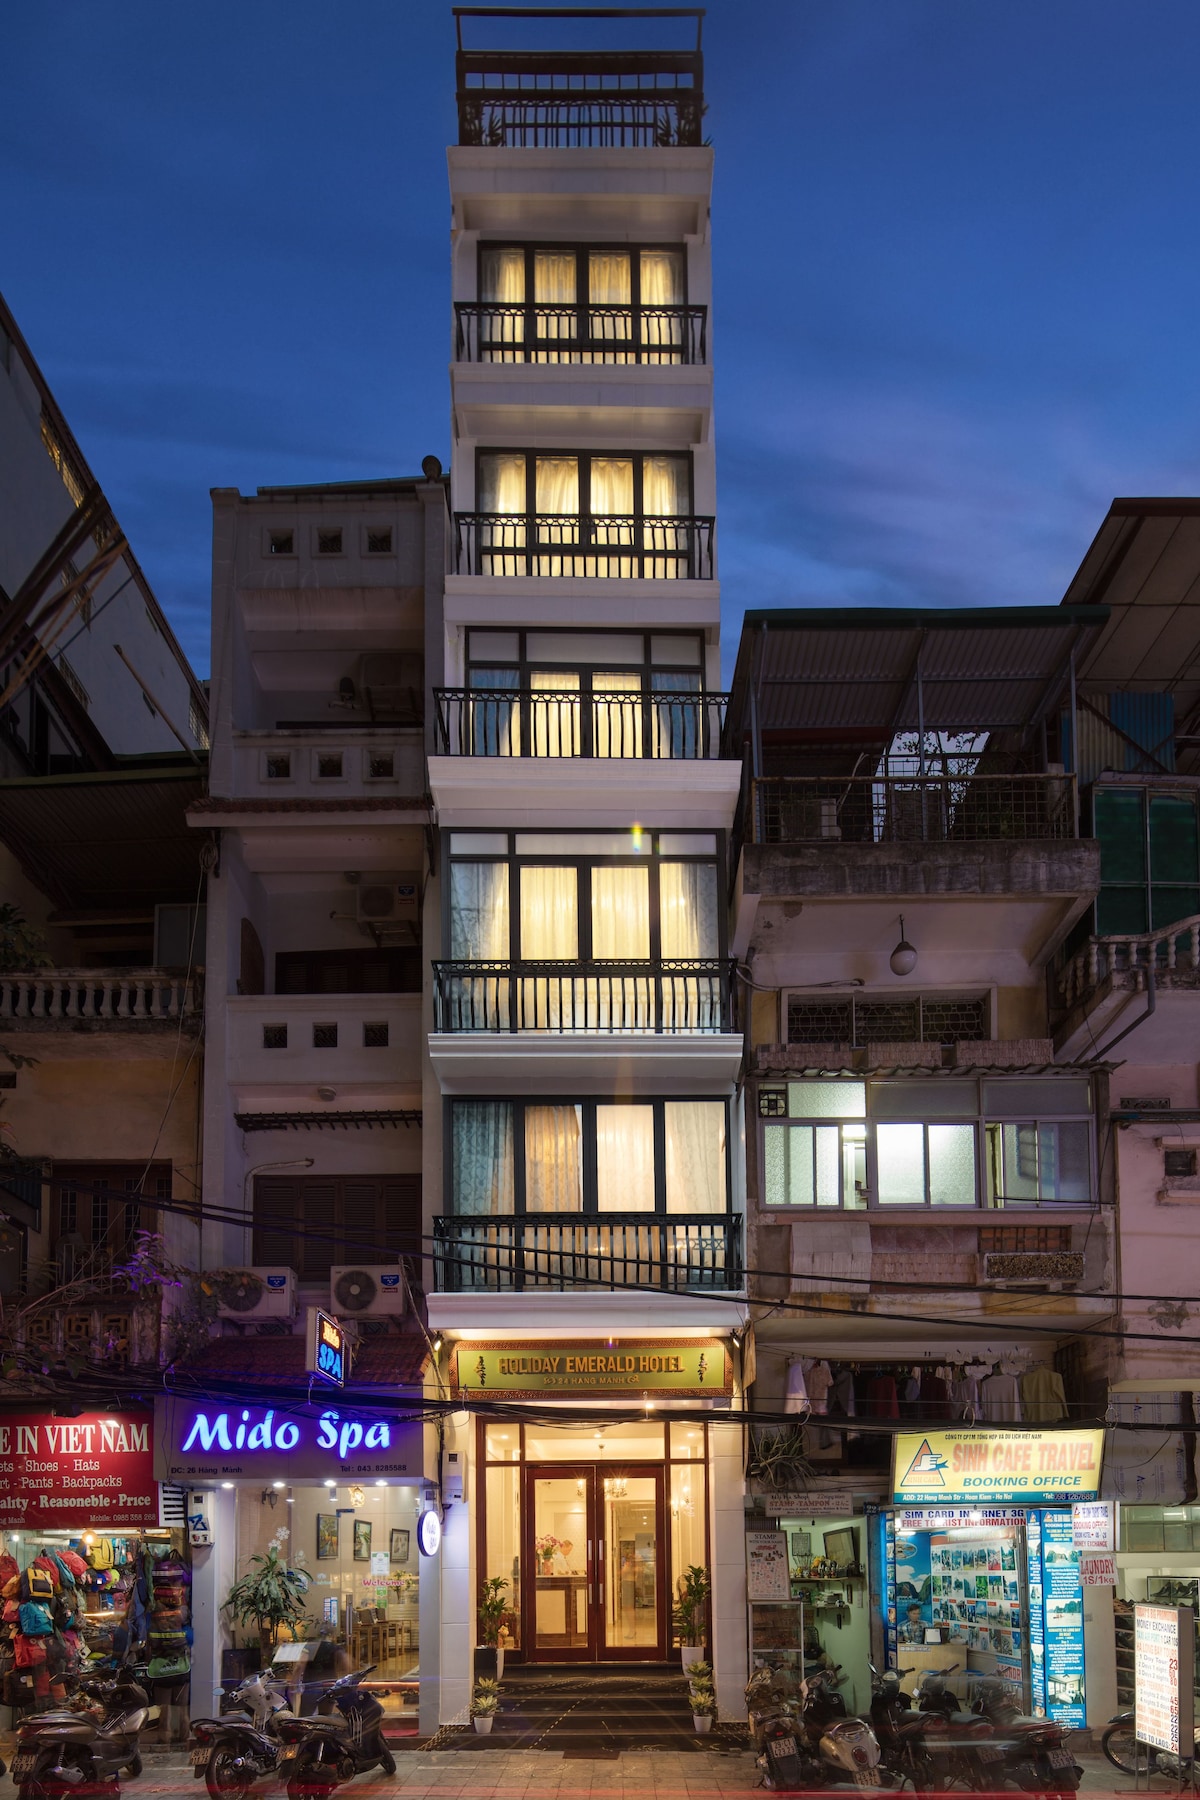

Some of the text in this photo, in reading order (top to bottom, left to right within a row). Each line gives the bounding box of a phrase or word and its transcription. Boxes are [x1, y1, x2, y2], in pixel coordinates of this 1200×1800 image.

[319, 1344, 342, 1378] SPA
[498, 1355, 685, 1374] HOLIDAY EMERALD HOTEL
[16, 1426, 39, 1454] IN
[44, 1424, 96, 1454] VIET
[100, 1424, 149, 1453] NAM
[182, 1410, 391, 1459] Mido Spa
[952, 1442, 1096, 1473] SINH CAFE TRAVEL
[26, 1460, 58, 1472] Shoes
[73, 1459, 100, 1471] Hats
[21, 1477, 53, 1489] Pants
[62, 1475, 122, 1490] Backpacks
[963, 1476, 1082, 1487] BOOKING OFFICE
[40, 1495, 110, 1508] Reasoneble
[118, 1494, 151, 1507] Price
[1081, 1558, 1114, 1575] LAUNDRY
[1153, 1622, 1176, 1634] EXCHANGE
[1169, 1658, 1178, 1670] 23
[1170, 1696, 1178, 1706] 45
[1170, 1705, 1178, 1715] 65
[1171, 1714, 1178, 1724] 22
[1171, 1724, 1178, 1733] 22
[1137, 1731, 1147, 1740] BUS
[1149, 1735, 1154, 1743] TO
[1171, 1742, 1178, 1752] 24
[1171, 1733, 1178, 1742] 25
